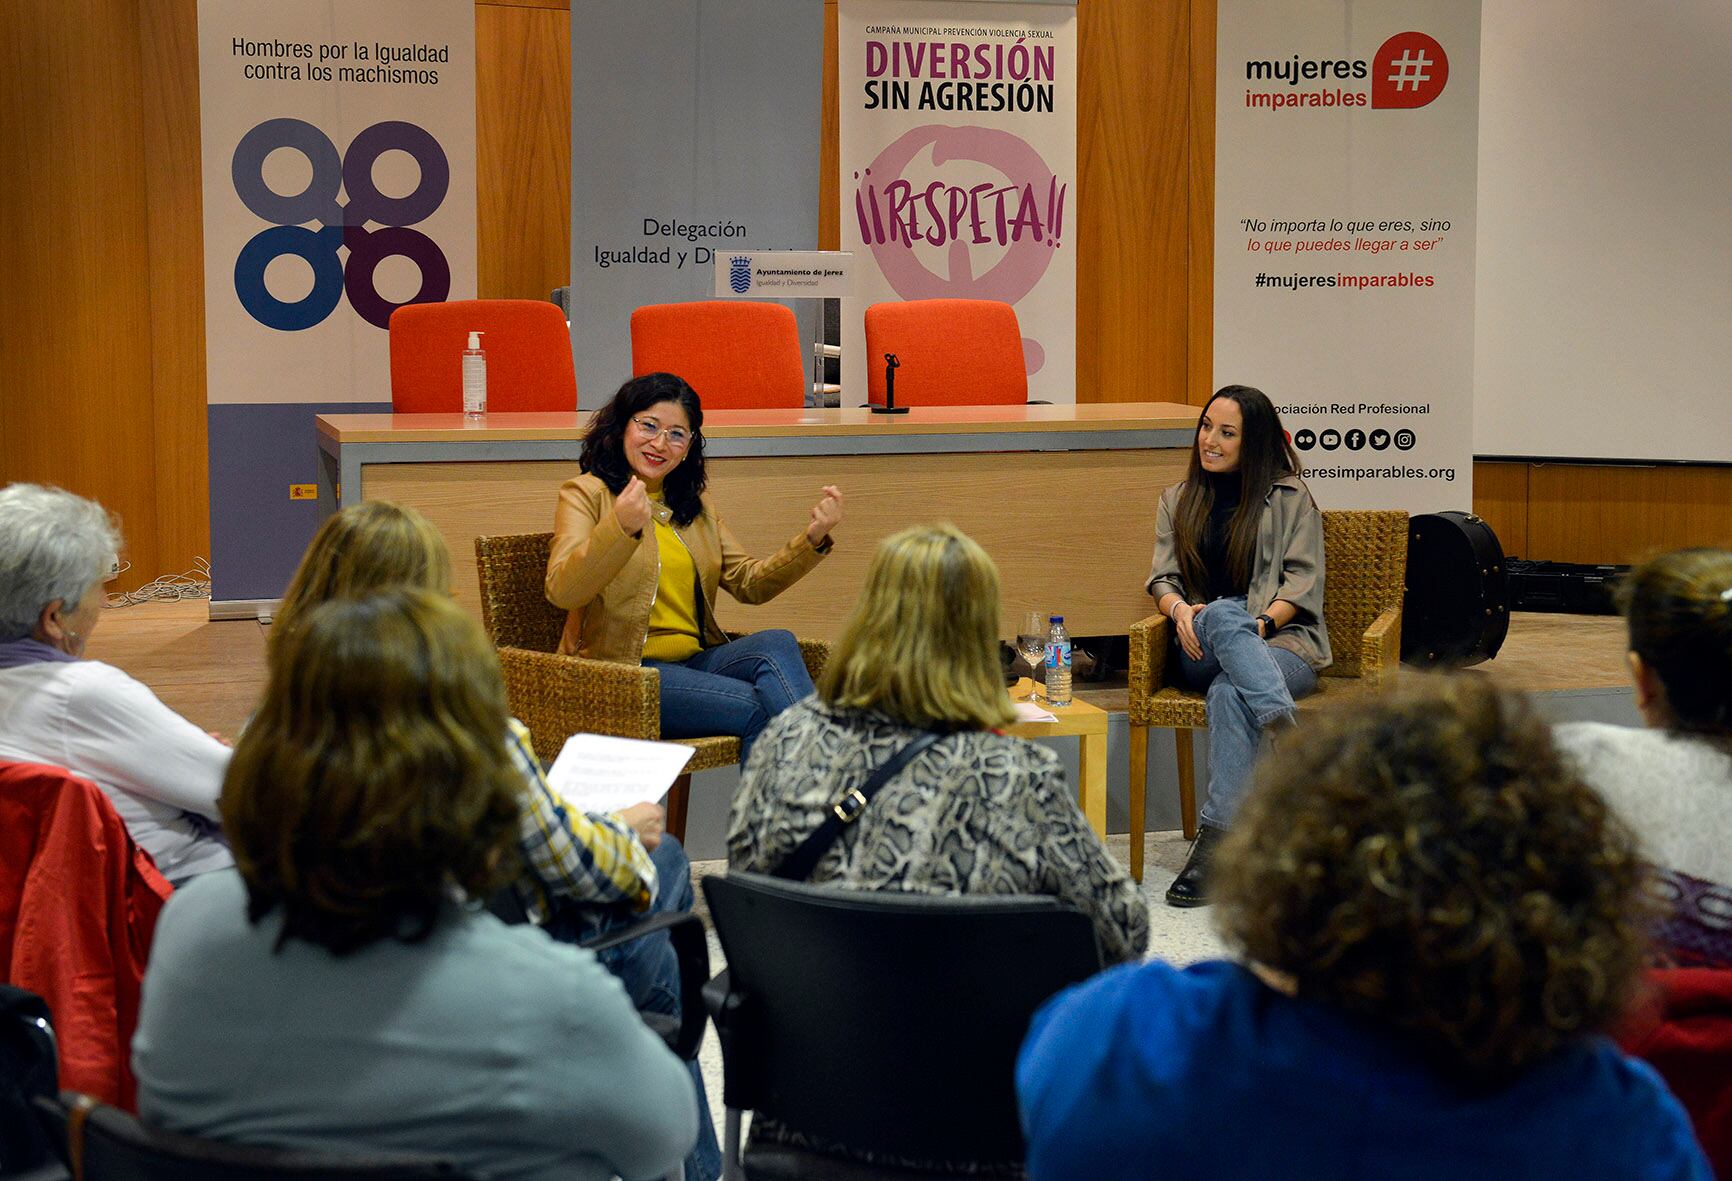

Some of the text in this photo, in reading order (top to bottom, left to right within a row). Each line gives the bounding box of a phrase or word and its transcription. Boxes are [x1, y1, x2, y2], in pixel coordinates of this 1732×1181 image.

[865, 25, 1054, 38] CAMPAÑA MUNICIPAL PREVENCIÓN VIOLENCIA SEXUAL
[232, 38, 449, 65] Hombres por la Igualdad
[866, 38, 1055, 81] DIVERSIÓN
[244, 62, 439, 85] contra los machismos
[1246, 55, 1367, 85] mujeres
[864, 77, 1054, 112] SIN AGRESIÓN
[1246, 89, 1367, 111] imparables
[643, 218, 747, 241] Delegación
[1270, 219, 1326, 234] importa
[1329, 218, 1343, 232] lo
[1346, 221, 1375, 234] que
[1378, 221, 1415, 234] eres,
[1420, 217, 1451, 231] sino
[1247, 238, 1261, 251] lo
[1264, 240, 1292, 254] que
[1295, 237, 1351, 254] puedes
[1354, 237, 1397, 254] llegar
[1399, 241, 1409, 251] a
[594, 245, 670, 268] Igualdad
[677, 250, 688, 269] y
[756, 268, 844, 277] Ayuntamiento de Jerez
[756, 279, 781, 287] Igualdad
[1255, 272, 1435, 290] #mujeresimparables
[1274, 403, 1430, 414] ociación Red Profesional
